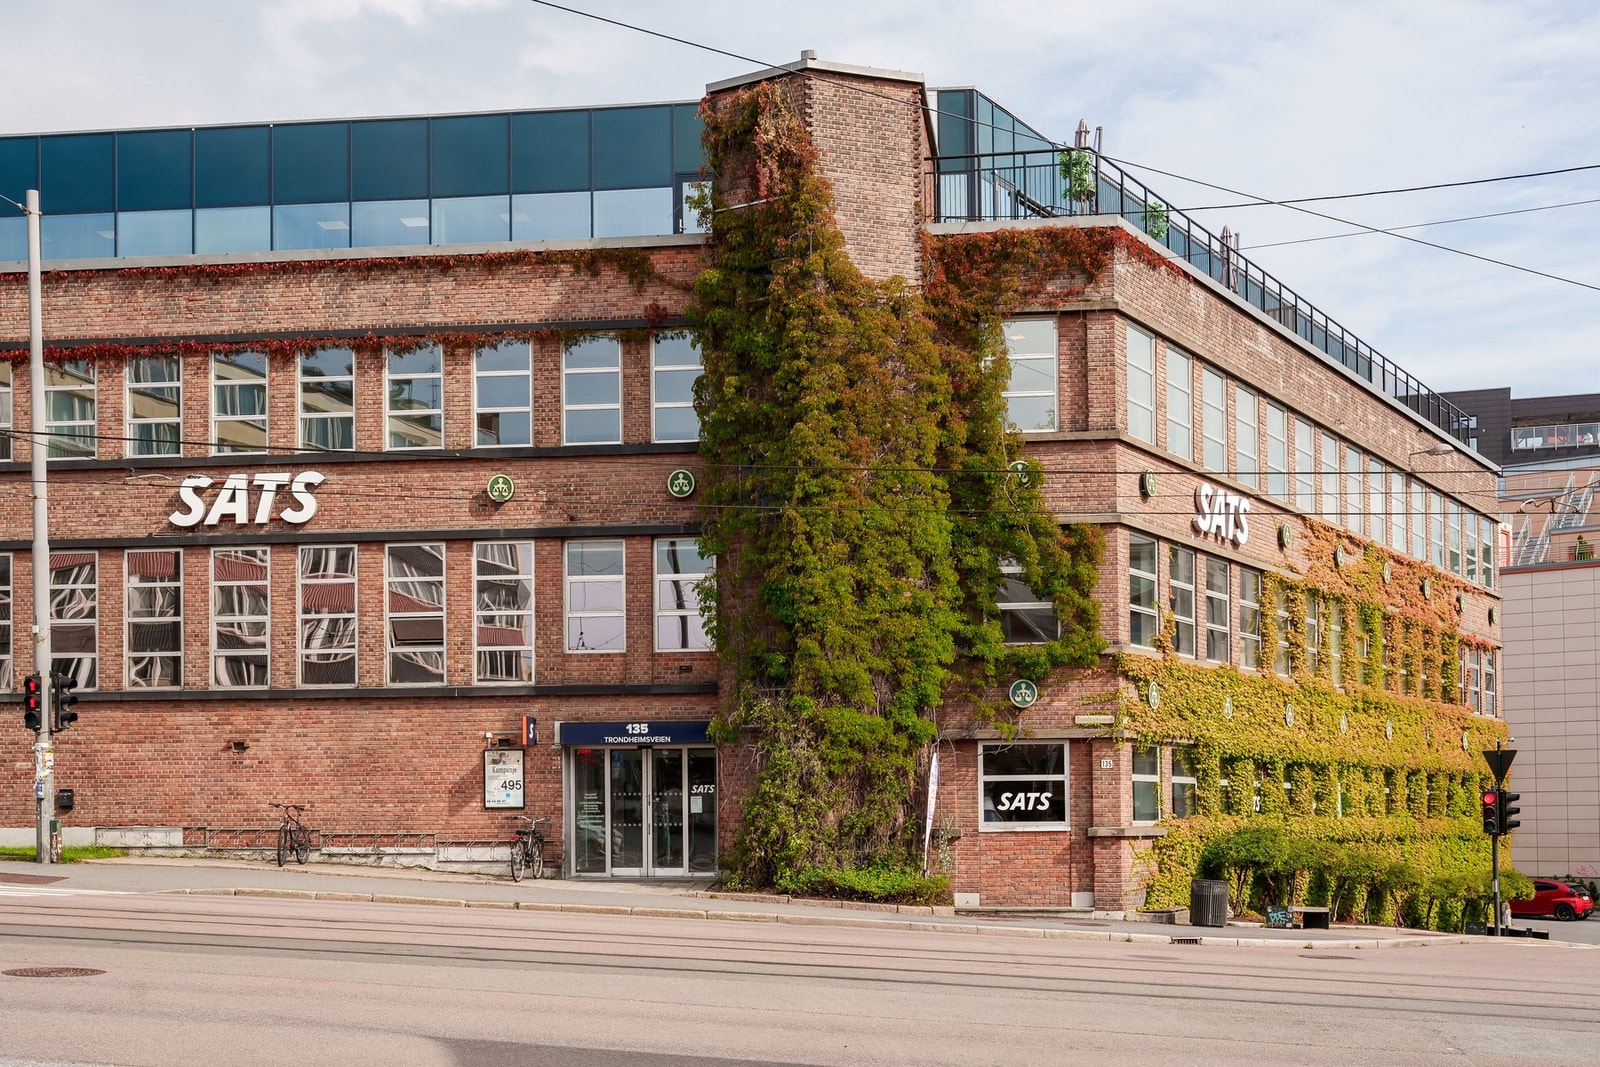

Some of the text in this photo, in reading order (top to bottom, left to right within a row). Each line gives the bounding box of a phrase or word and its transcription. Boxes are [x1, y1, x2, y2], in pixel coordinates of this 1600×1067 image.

[168, 471, 327, 527] SATS
[1194, 483, 1251, 545] SATS
[529, 723, 534, 738] S
[626, 723, 649, 734] 135
[1102, 760, 1112, 768] 135
[501, 780, 522, 791] 495
[691, 784, 715, 793] SATS
[997, 792, 1053, 811] SATS
